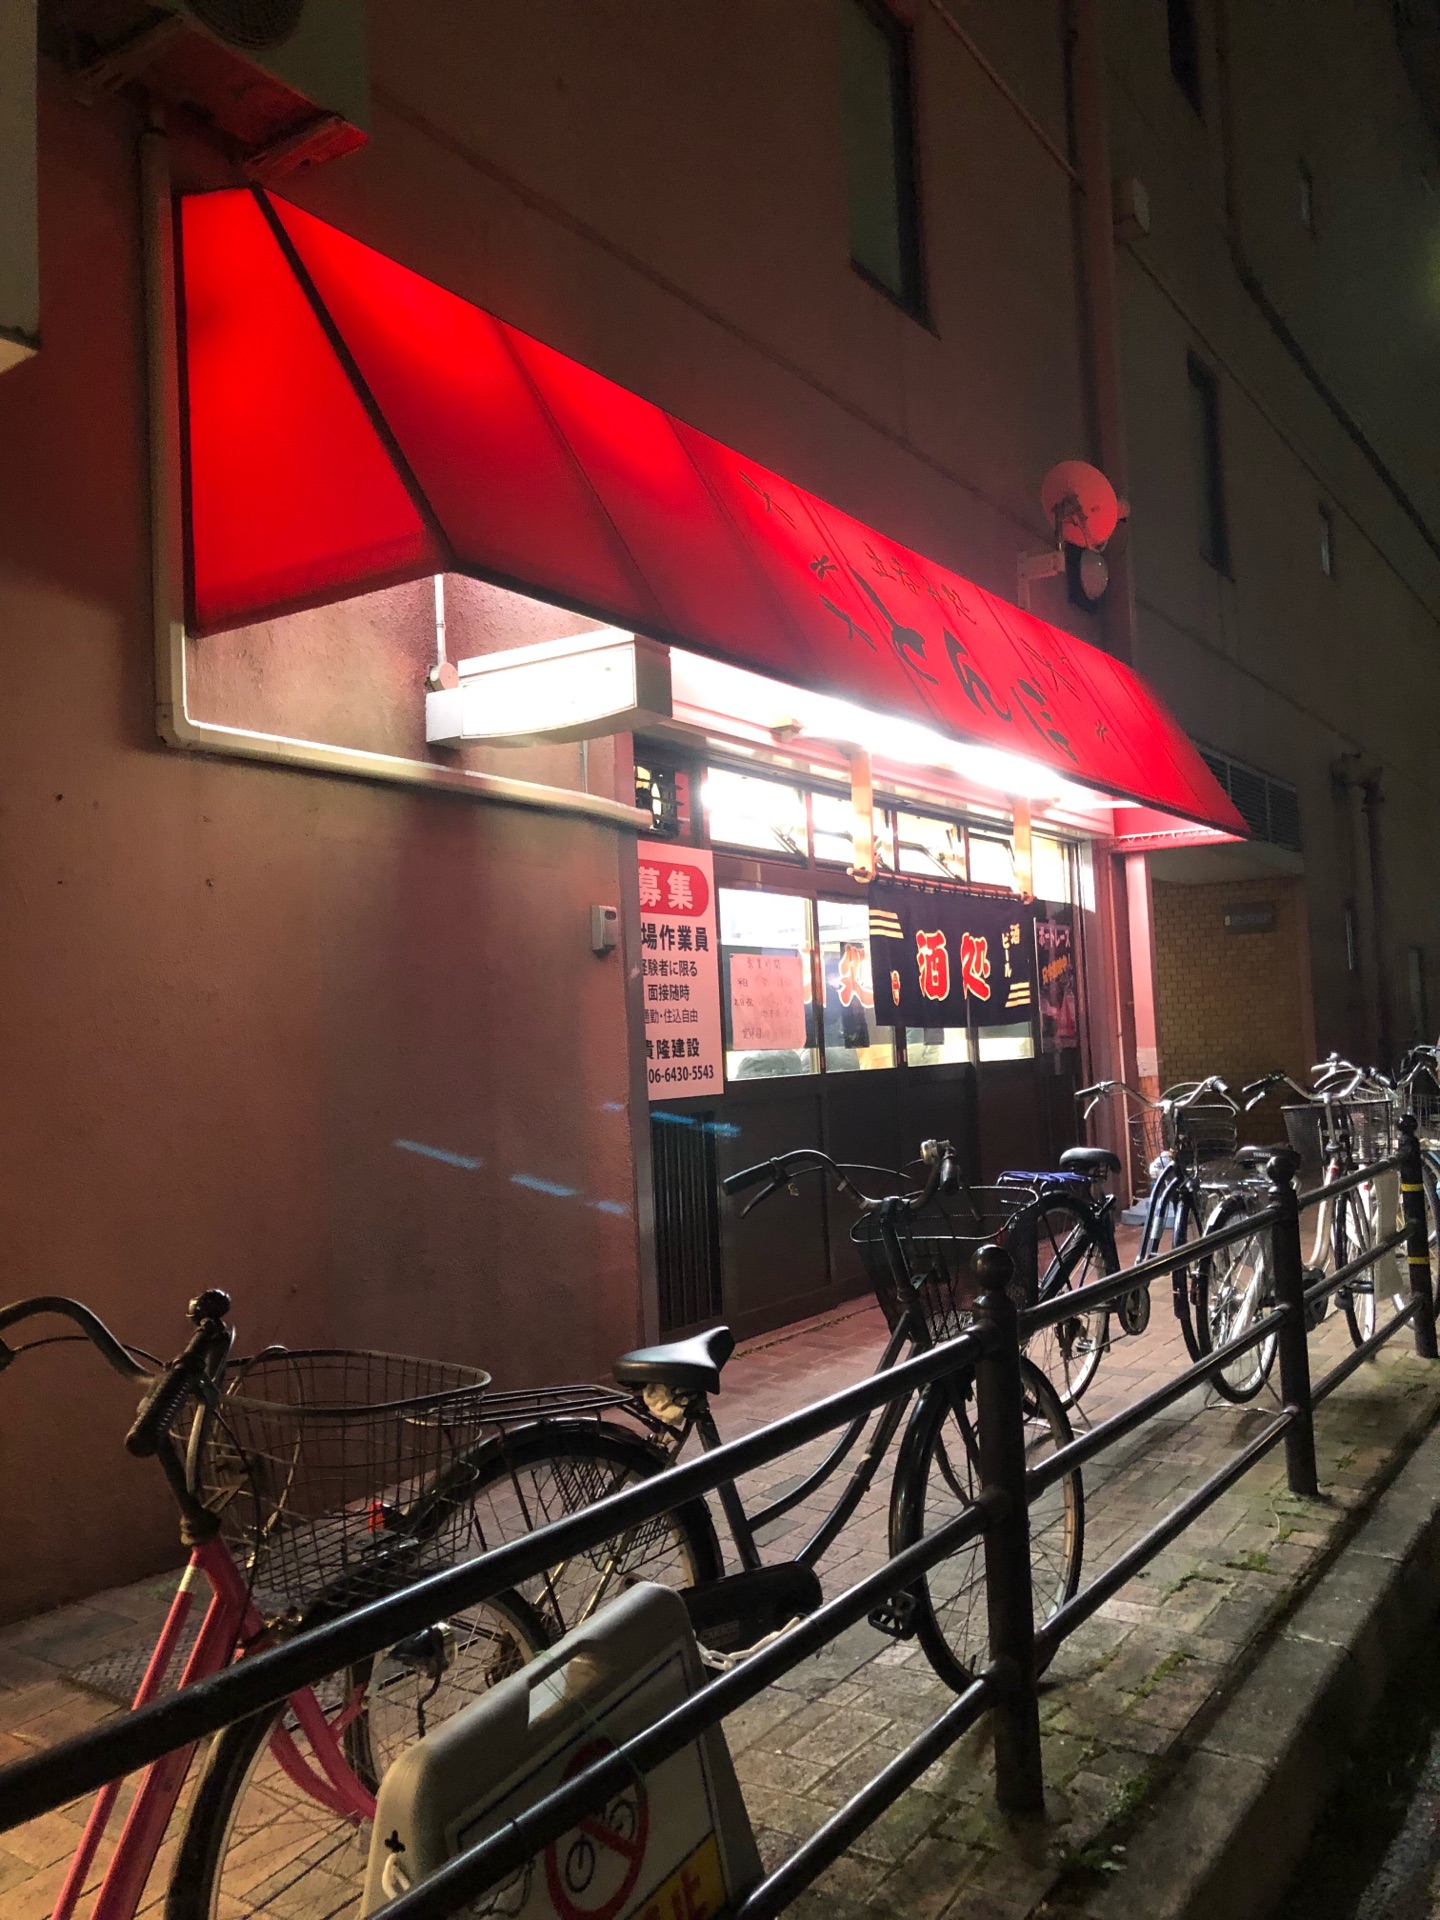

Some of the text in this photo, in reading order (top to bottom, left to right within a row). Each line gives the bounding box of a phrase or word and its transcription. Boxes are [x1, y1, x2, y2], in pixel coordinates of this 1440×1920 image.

[639, 866, 694, 910] 募集
[641, 922, 709, 952] 場作業員
[916, 929, 992, 1002] 酒処
[648, 984, 690, 1002] 面接随時
[648, 1064, 714, 1084] 06-6430-5543
